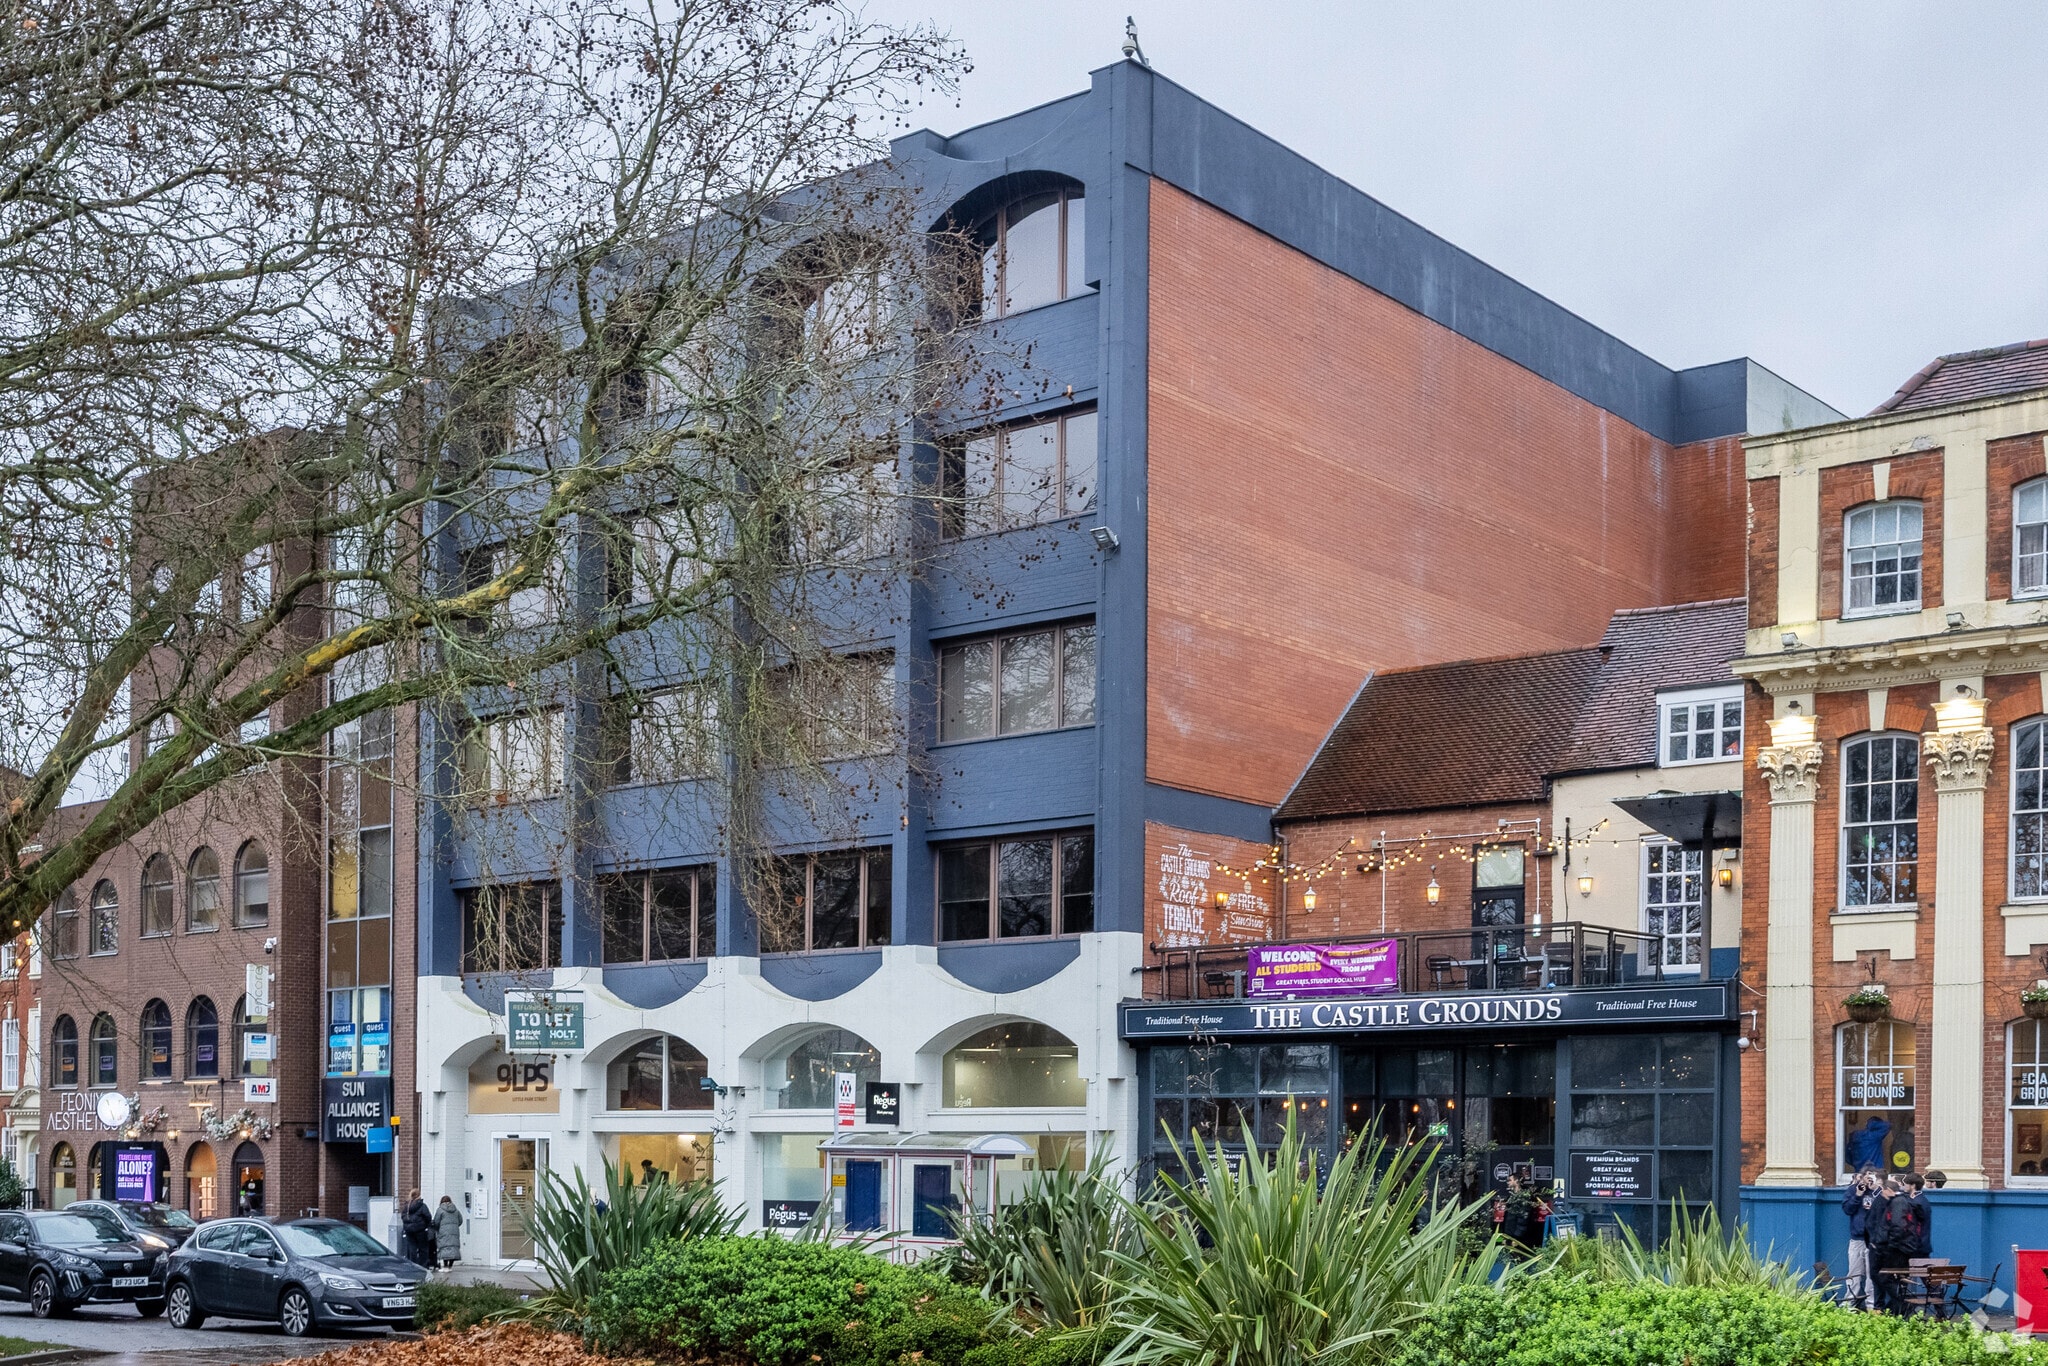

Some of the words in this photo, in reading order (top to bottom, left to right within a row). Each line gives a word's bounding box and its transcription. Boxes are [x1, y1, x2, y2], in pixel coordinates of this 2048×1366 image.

[1178, 843, 1193, 857] The
[1160, 853, 1184, 875] CASTLE
[1184, 858, 1210, 880] GROUNDS
[1169, 882, 1200, 909] Roof
[1237, 893, 1256, 911] FREE
[1162, 903, 1205, 934] TERRACE
[1260, 950, 1317, 963] WELCOME
[1255, 966, 1272, 977] ALL
[1273, 961, 1322, 974] STUDENTS
[1341, 965, 1360, 973] FROM
[1310, 977, 1333, 985] STUDENT
[254, 966, 263, 1015] encore
[1595, 1000, 1644, 1011] Traditional
[1646, 999, 1667, 1009] Free
[1668, 998, 1698, 1008] House
[518, 1012, 541, 1027] TO
[544, 1012, 574, 1027] LET
[1145, 1015, 1184, 1026] Traditional
[1200, 1015, 1224, 1025] House
[1250, 1005, 1302, 1029] THE
[1311, 1004, 1410, 1028] CASTLE
[1418, 998, 1562, 1024] GROUNDS
[333, 1024, 352, 1034] quest
[366, 1023, 384, 1033] quest
[333, 1050, 352, 1060] 02476
[1857, 1072, 1905, 1085] CASTLE
[342, 1081, 365, 1098] SUN
[1850, 1086, 1905, 1099] GROUNDS
[873, 1094, 897, 1109] Regus
[327, 1102, 381, 1118] ALLIANCE
[117, 1160, 153, 1175] ALONE?
[769, 1207, 797, 1225] Regus
[387, 1298, 405, 1307] VN63
